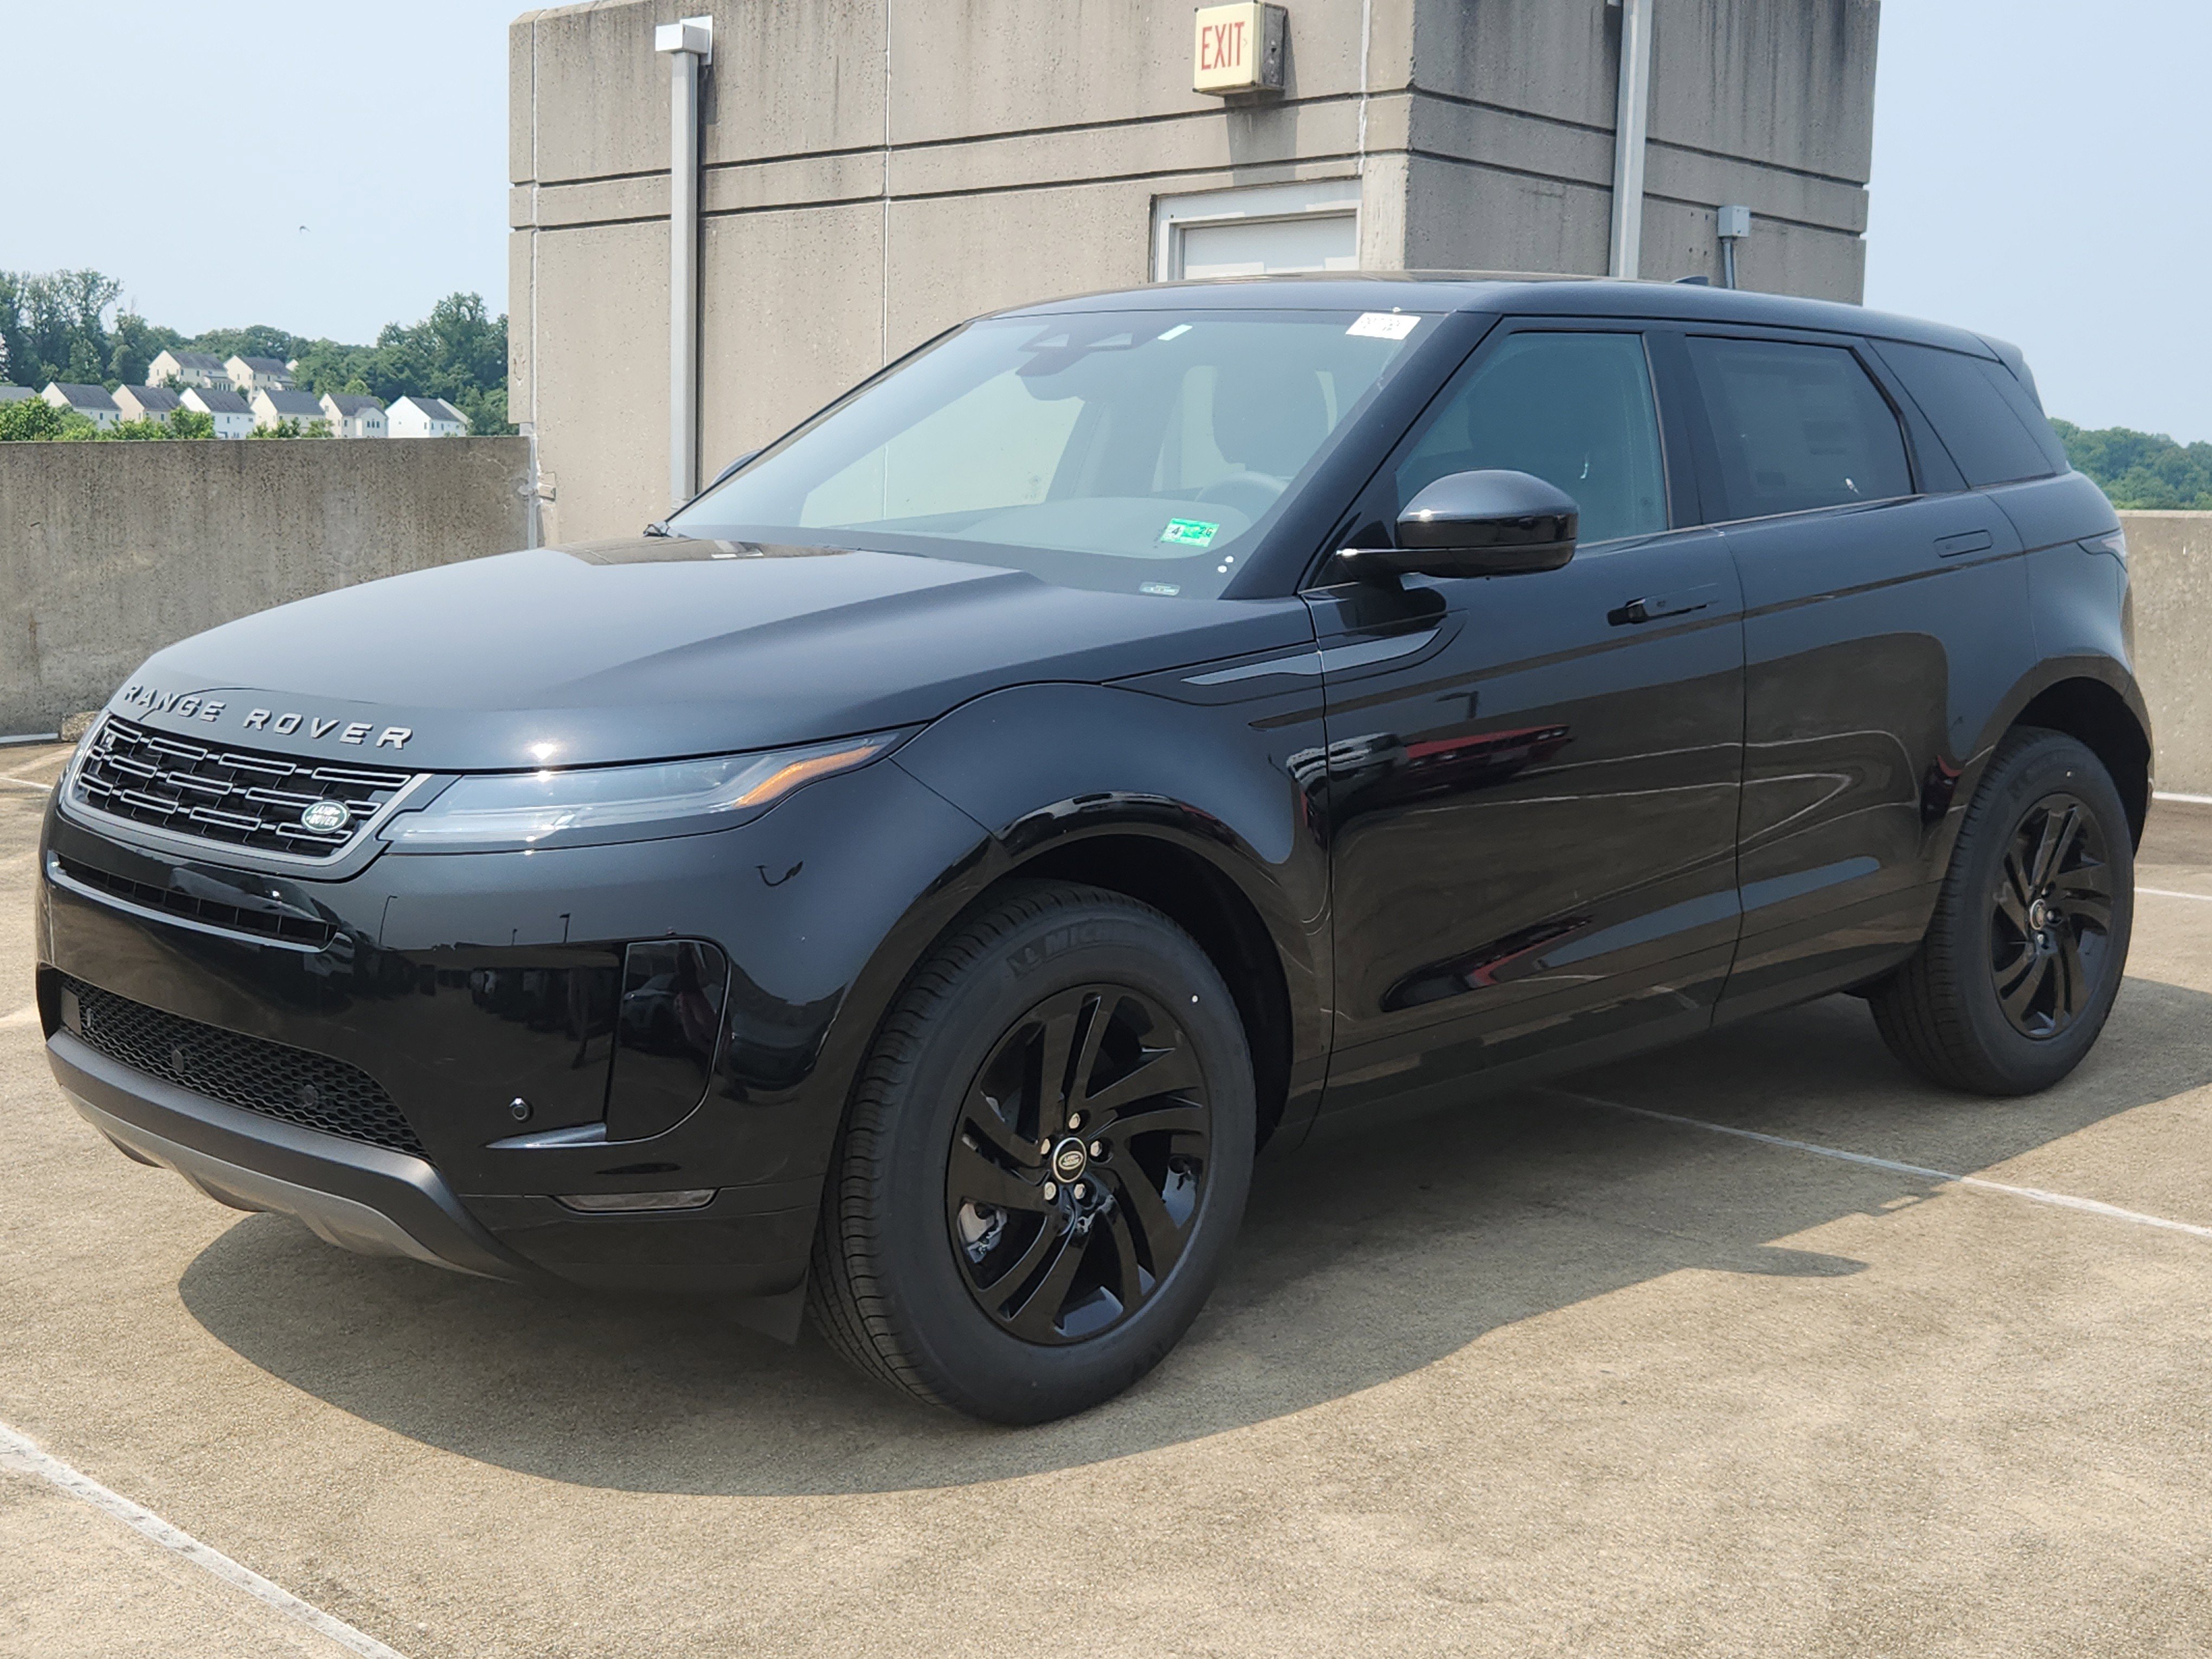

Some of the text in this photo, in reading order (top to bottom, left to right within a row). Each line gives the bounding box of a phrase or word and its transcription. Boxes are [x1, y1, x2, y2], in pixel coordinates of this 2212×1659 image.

[1201, 21, 1245, 70] EXIT
[124, 685, 413, 749] RANGE ROVER
